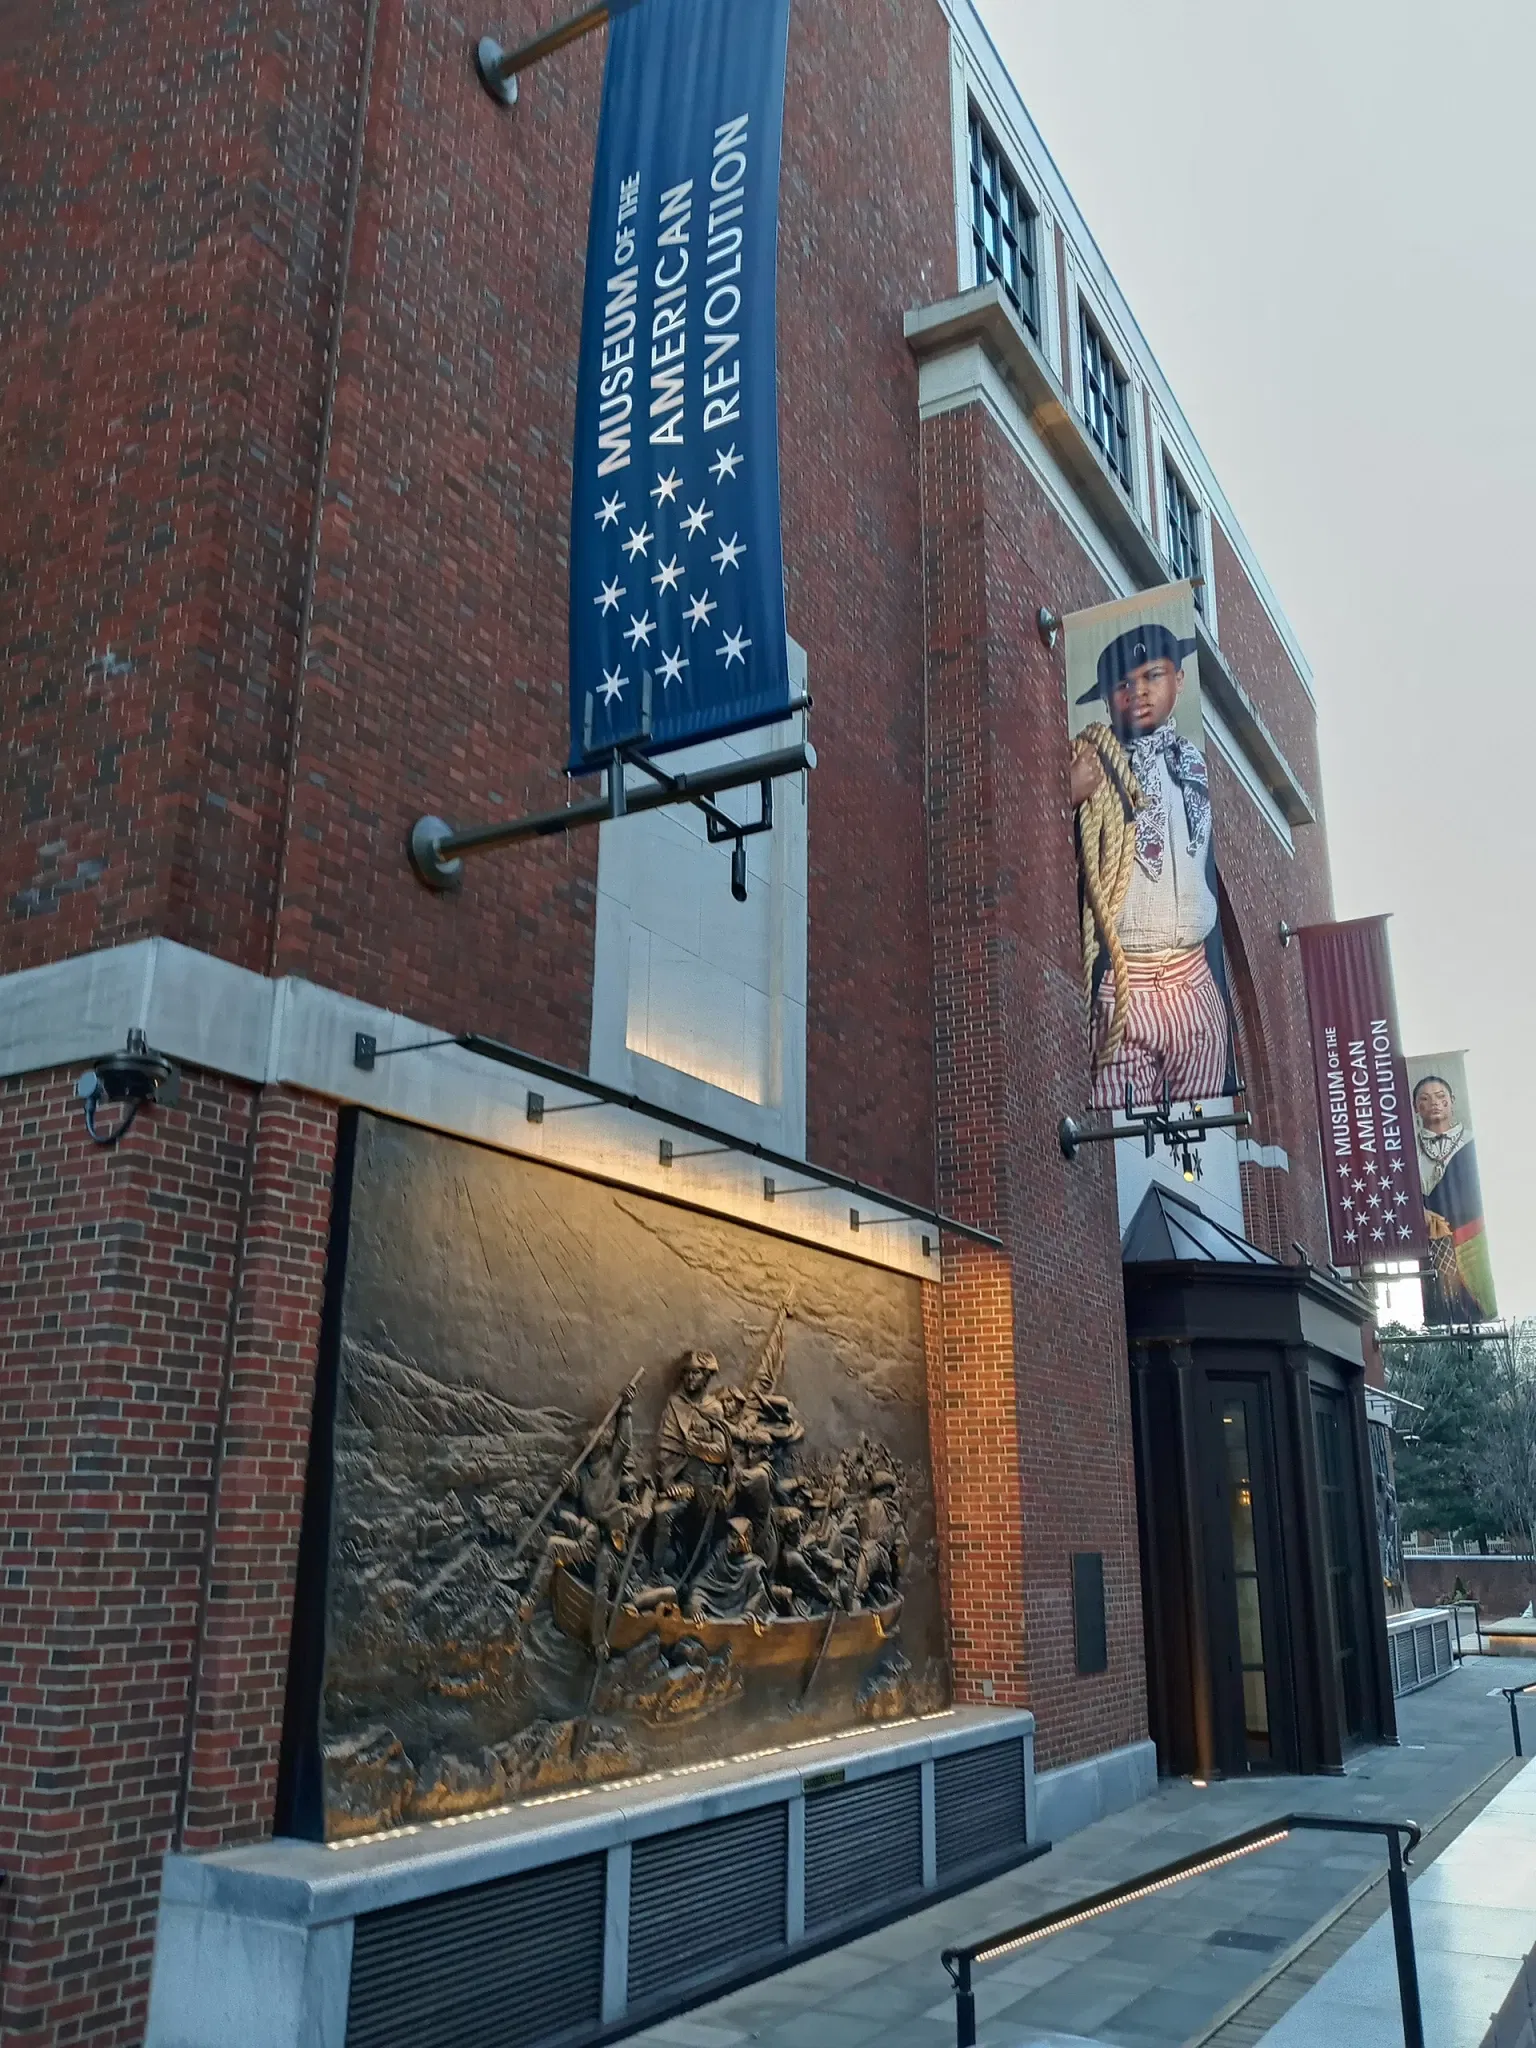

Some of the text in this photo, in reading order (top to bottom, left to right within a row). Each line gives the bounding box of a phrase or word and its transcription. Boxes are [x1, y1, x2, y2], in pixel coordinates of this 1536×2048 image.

[597, 170, 640, 478] MUSEUM OF THE
[649, 178, 693, 444] AMERICAN
[703, 112, 749, 432] REVOLUTION
[1325, 1026, 1352, 1156] MUSEUM OF THE
[1348, 1040, 1377, 1153] AMERICAN
[1370, 1019, 1402, 1151] REVOLUTION
